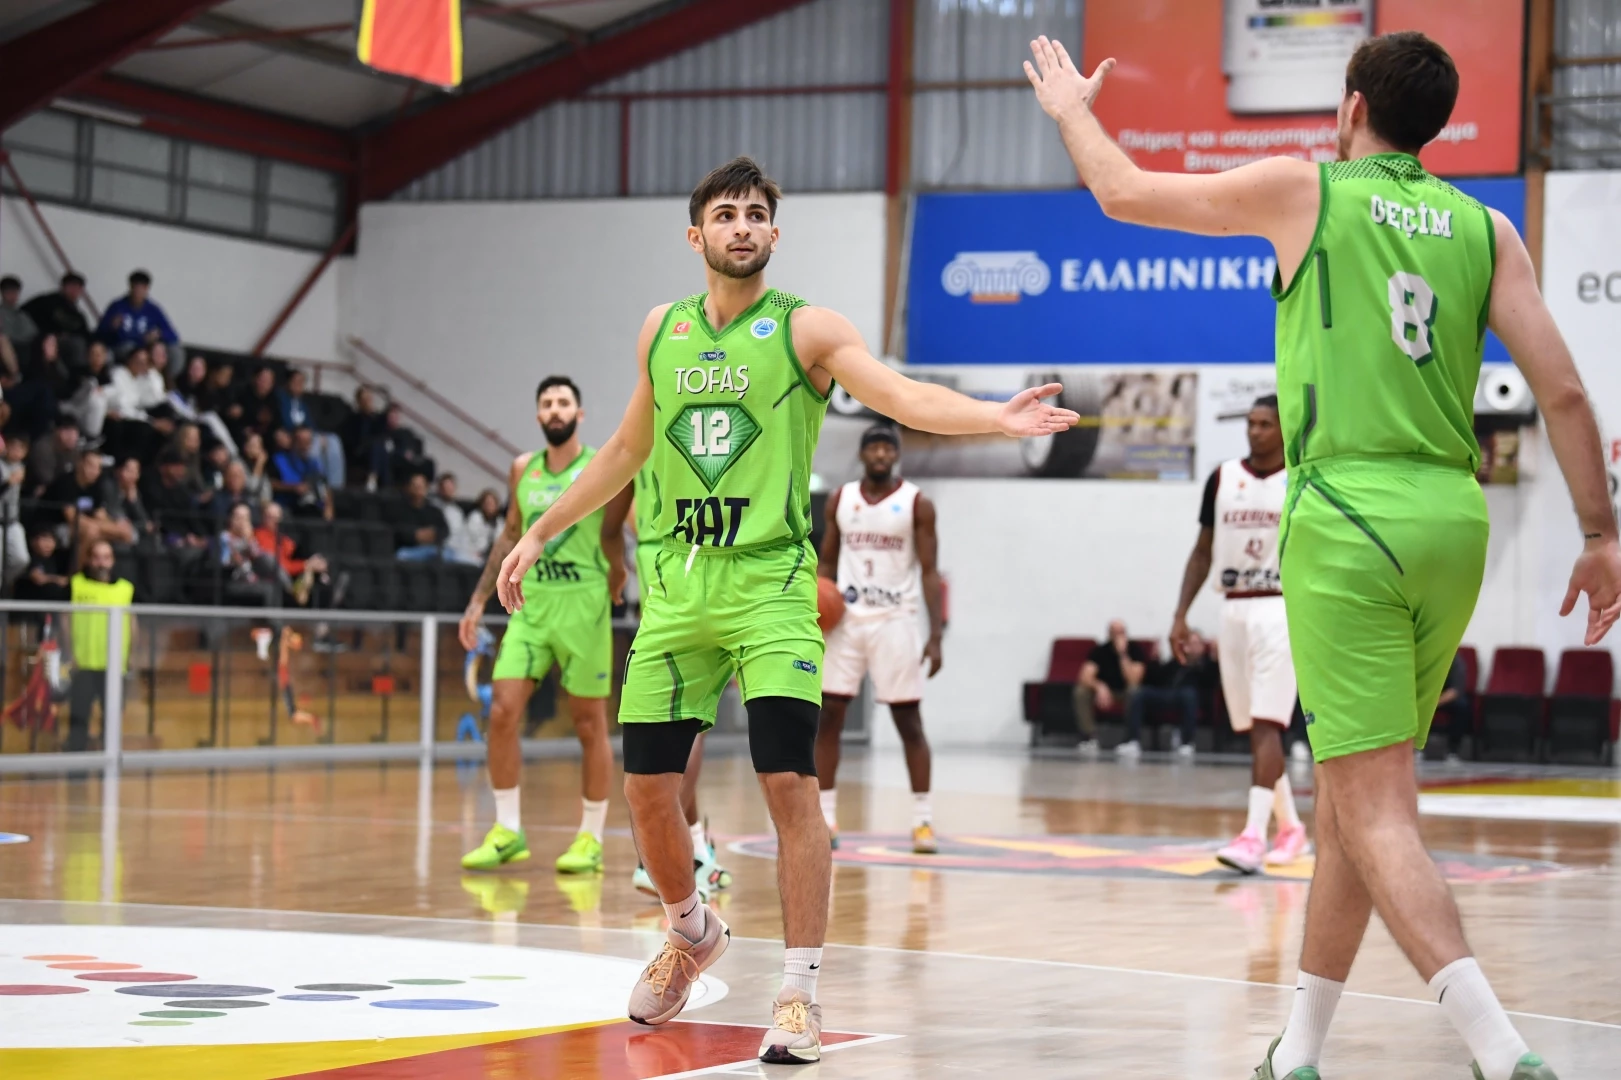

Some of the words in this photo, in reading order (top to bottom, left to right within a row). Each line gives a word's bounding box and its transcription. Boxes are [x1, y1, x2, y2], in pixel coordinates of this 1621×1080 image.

[1371, 194, 1453, 239] GEÇİM
[1388, 270, 1438, 367] 8
[674, 365, 750, 400] TOFAŞ
[690, 410, 733, 457] 12
[673, 497, 750, 547] FIAT
